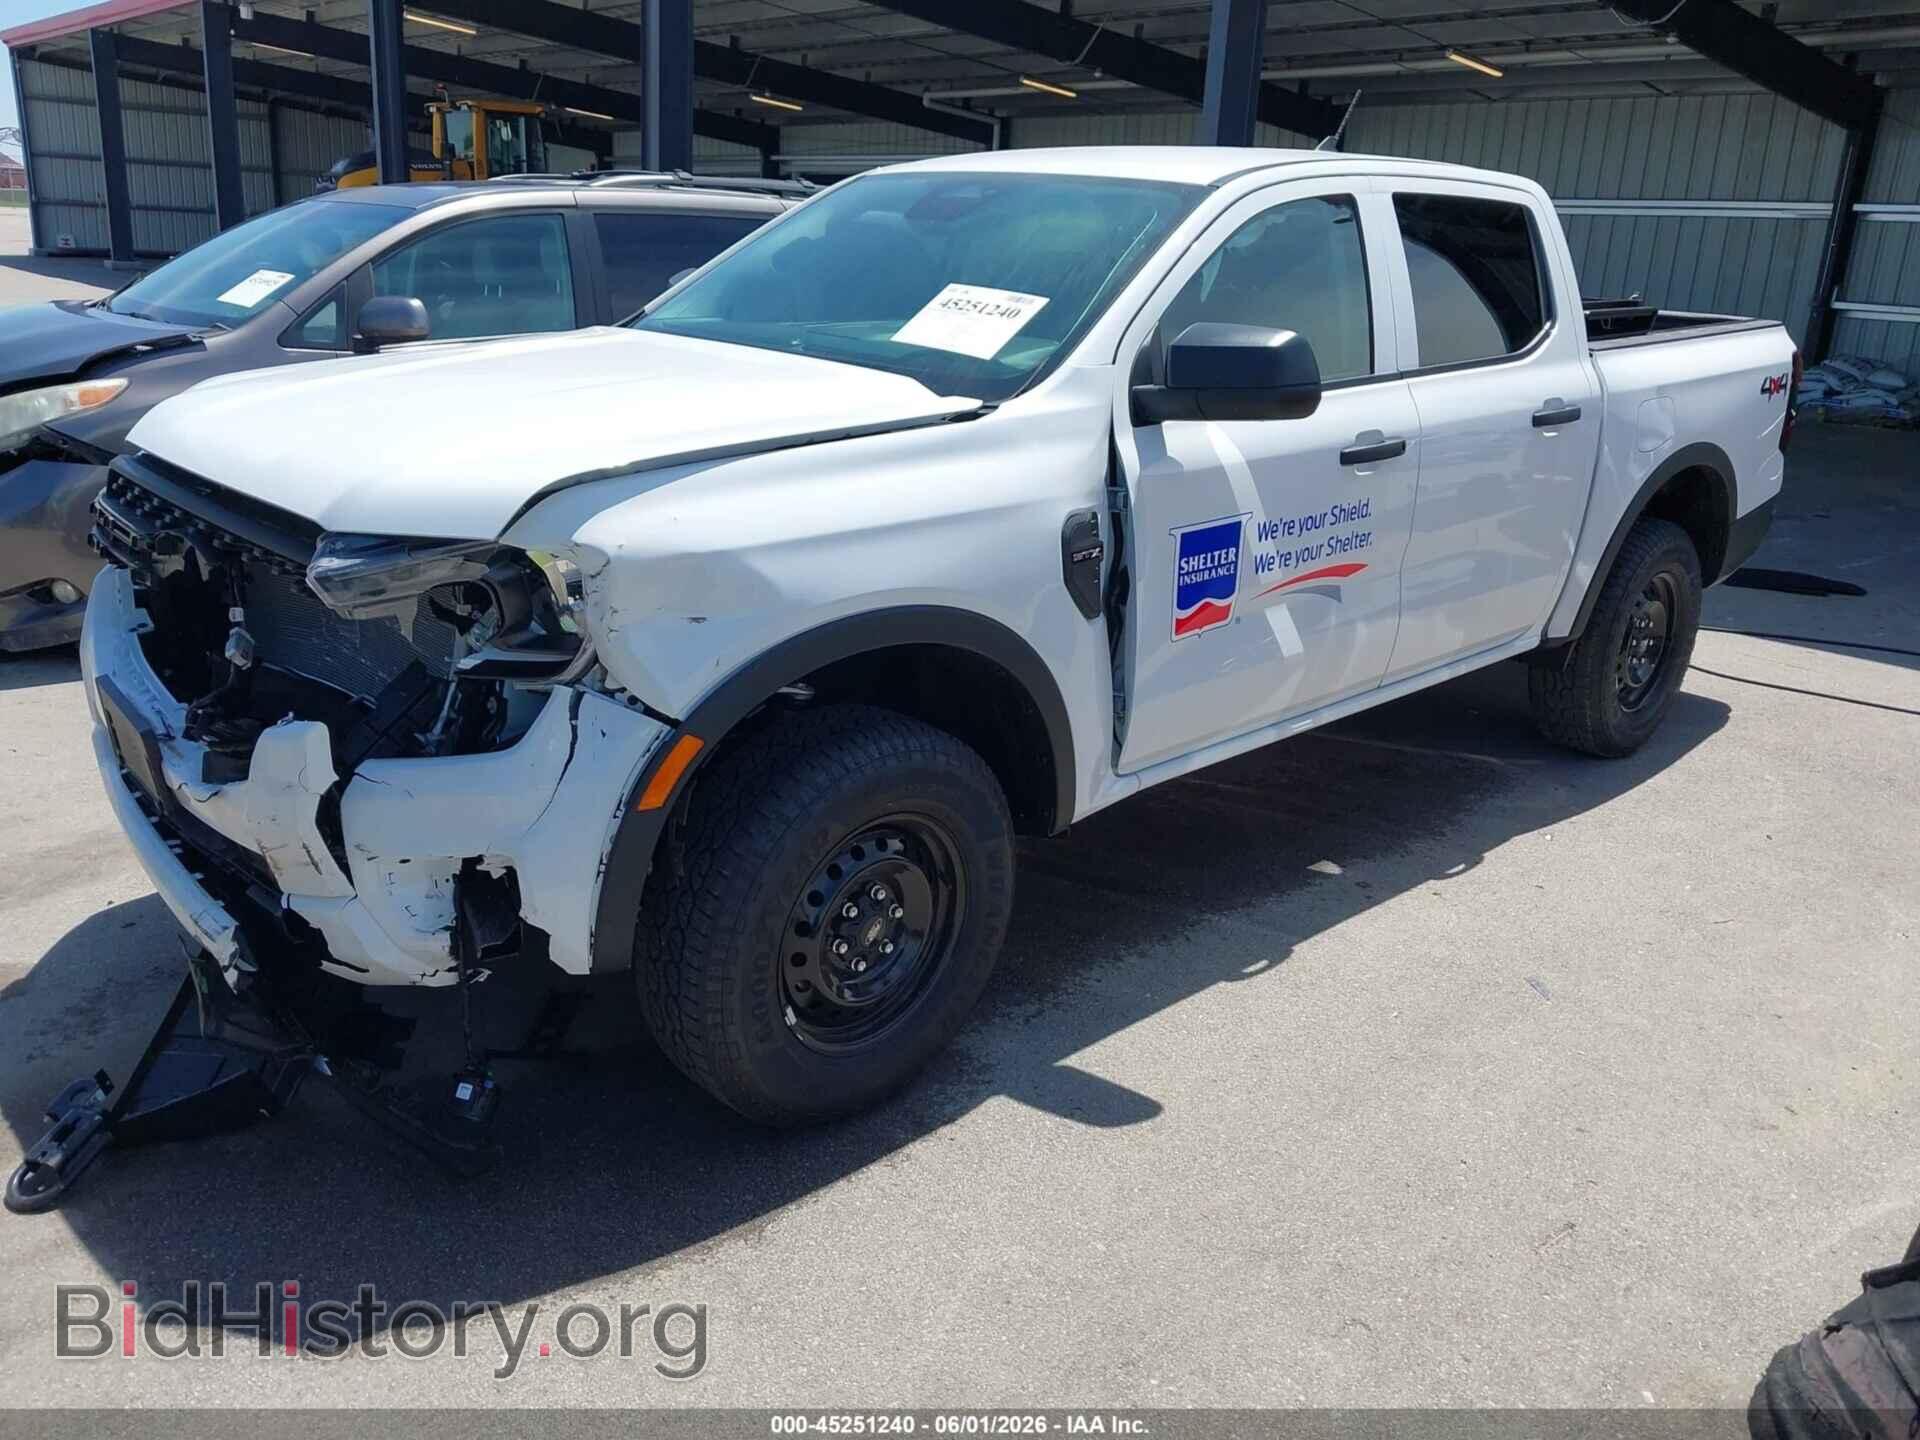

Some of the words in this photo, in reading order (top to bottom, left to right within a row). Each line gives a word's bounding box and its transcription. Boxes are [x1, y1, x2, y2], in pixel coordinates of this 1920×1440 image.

[939, 297, 1022, 320] 45251240
[1257, 518, 1295, 543] We're
[1297, 512, 1328, 538] your
[1329, 497, 1372, 526] Shield.
[1180, 547, 1236, 574] SHELTER
[1254, 550, 1292, 575] We're
[1294, 543, 1324, 569] your
[1325, 531, 1373, 557] Shelter.
[1179, 563, 1235, 586] INSURANCE
